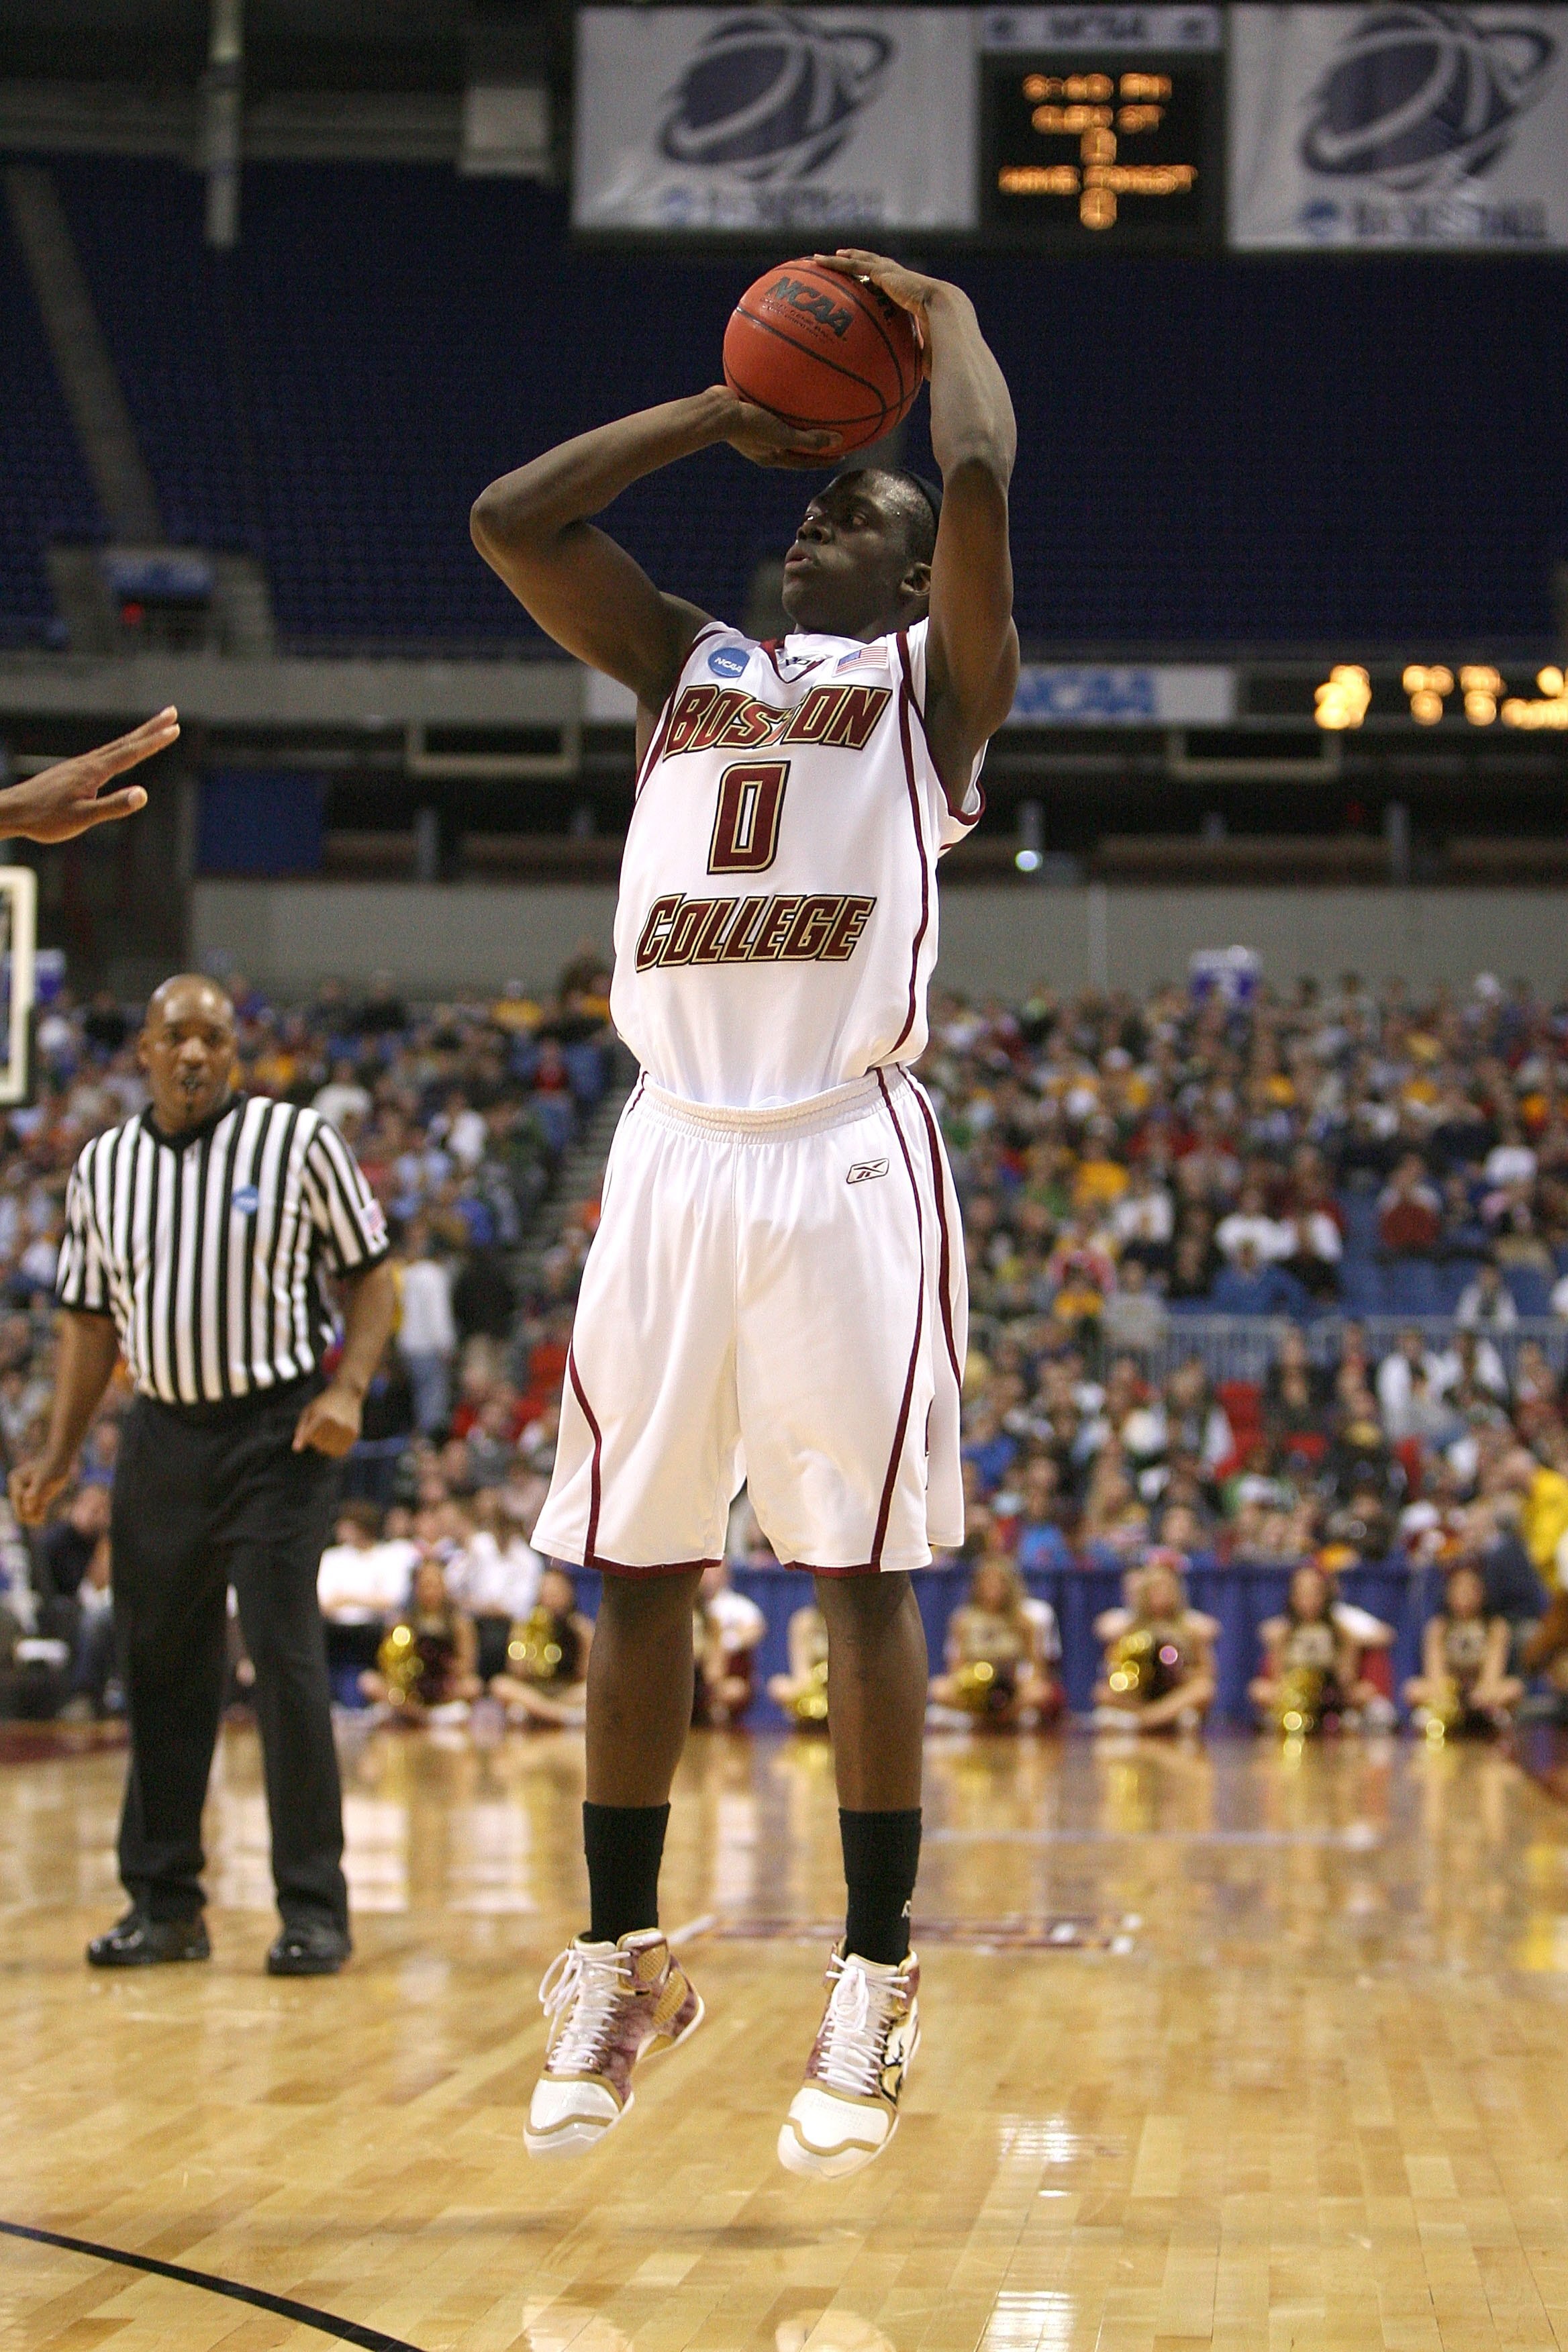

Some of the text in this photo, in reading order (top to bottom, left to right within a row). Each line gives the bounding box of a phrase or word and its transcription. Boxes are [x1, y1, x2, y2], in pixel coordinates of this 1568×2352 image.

[765, 276, 853, 338] NCAA
[714, 656, 743, 673] NCAA
[706, 760, 791, 875] 0
[634, 893, 877, 973] COLLEGE
